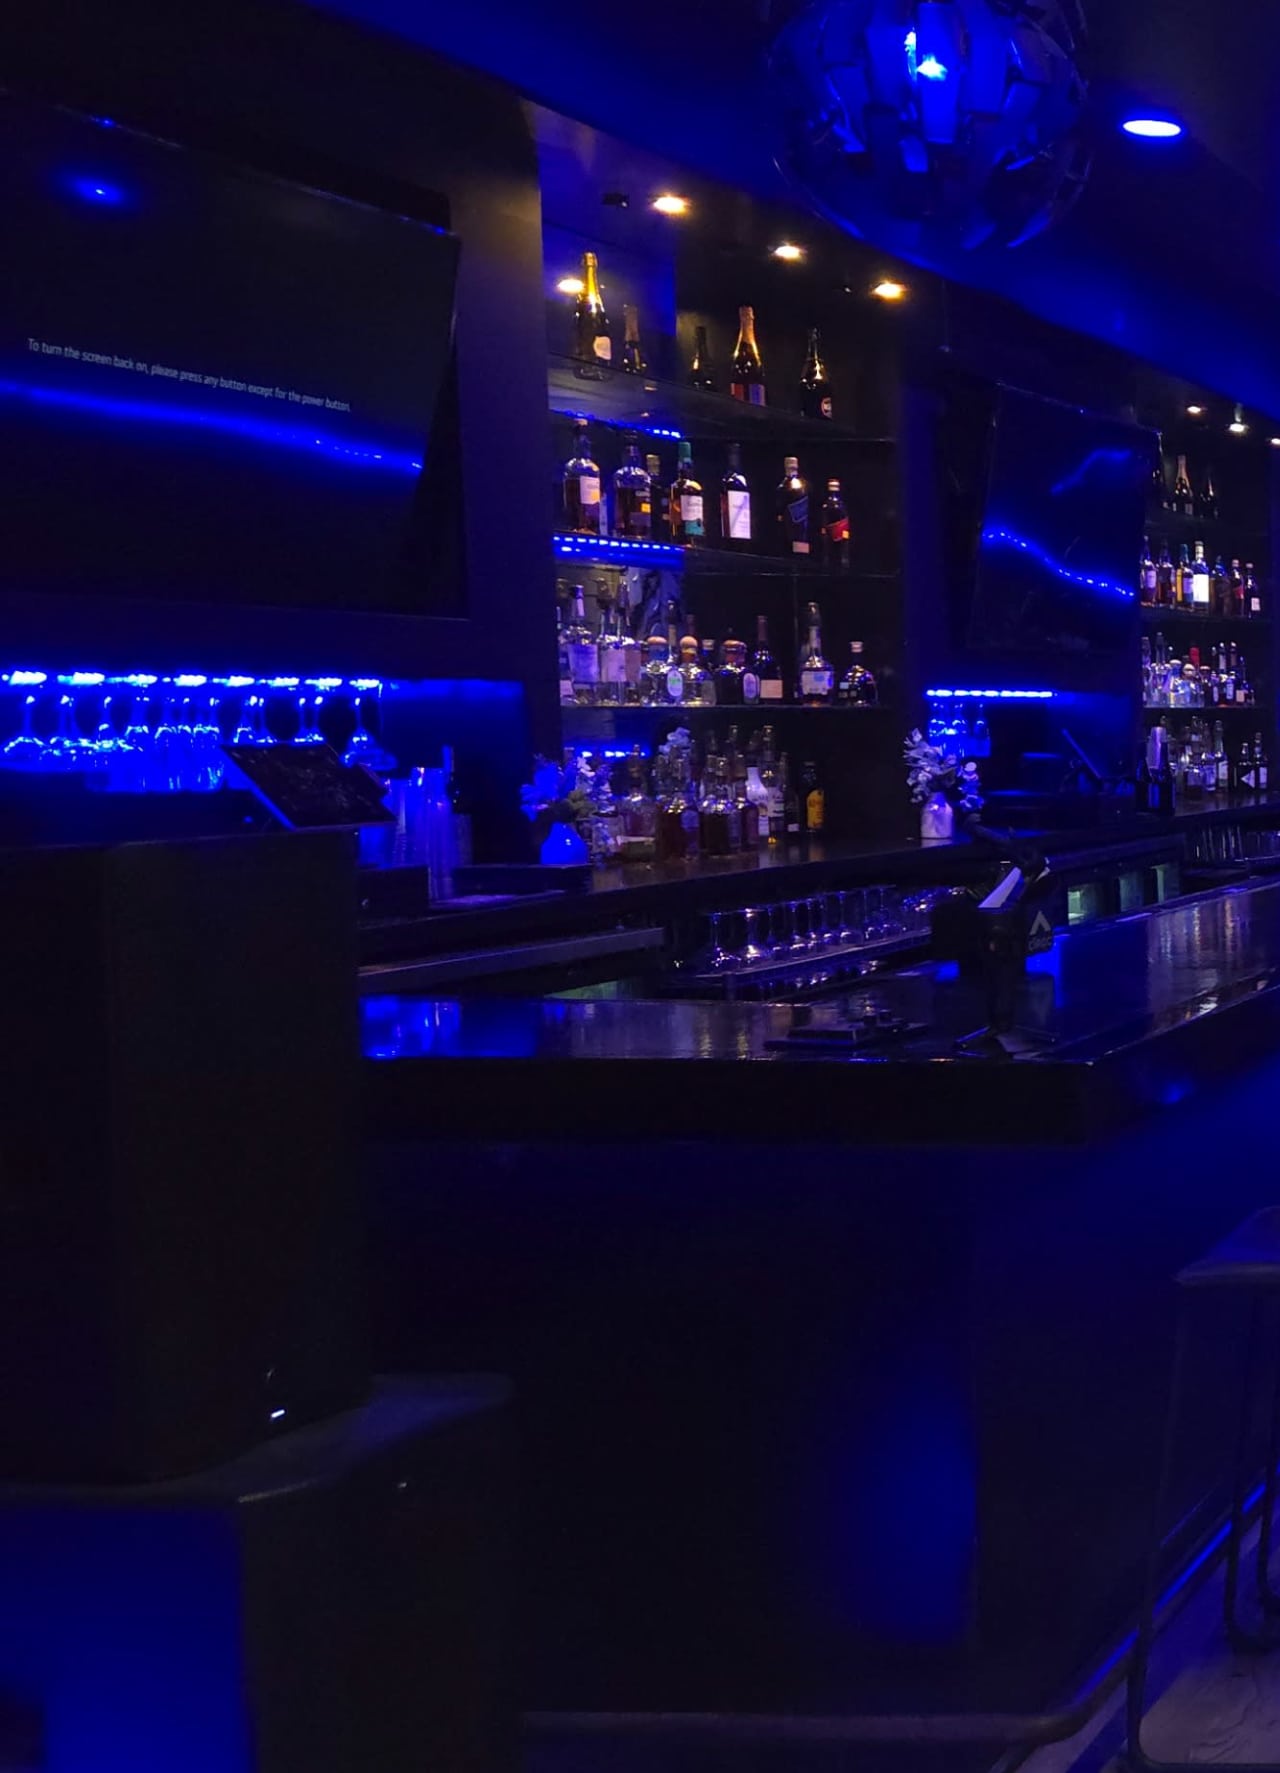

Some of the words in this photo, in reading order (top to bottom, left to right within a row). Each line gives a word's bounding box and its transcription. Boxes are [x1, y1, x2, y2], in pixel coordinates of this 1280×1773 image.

[28, 338, 39, 351] To
[42, 342, 62, 355] turn
[64, 347, 80, 359] the
[82, 352, 112, 366] screen
[113, 356, 134, 369] back
[151, 365, 178, 379] please
[180, 371, 202, 383] press
[203, 376, 218, 388] any
[219, 377, 246, 391] button
[248, 385, 273, 398] except
[275, 387, 287, 399] for
[289, 390, 301, 402] the
[302, 395, 324, 406] power
